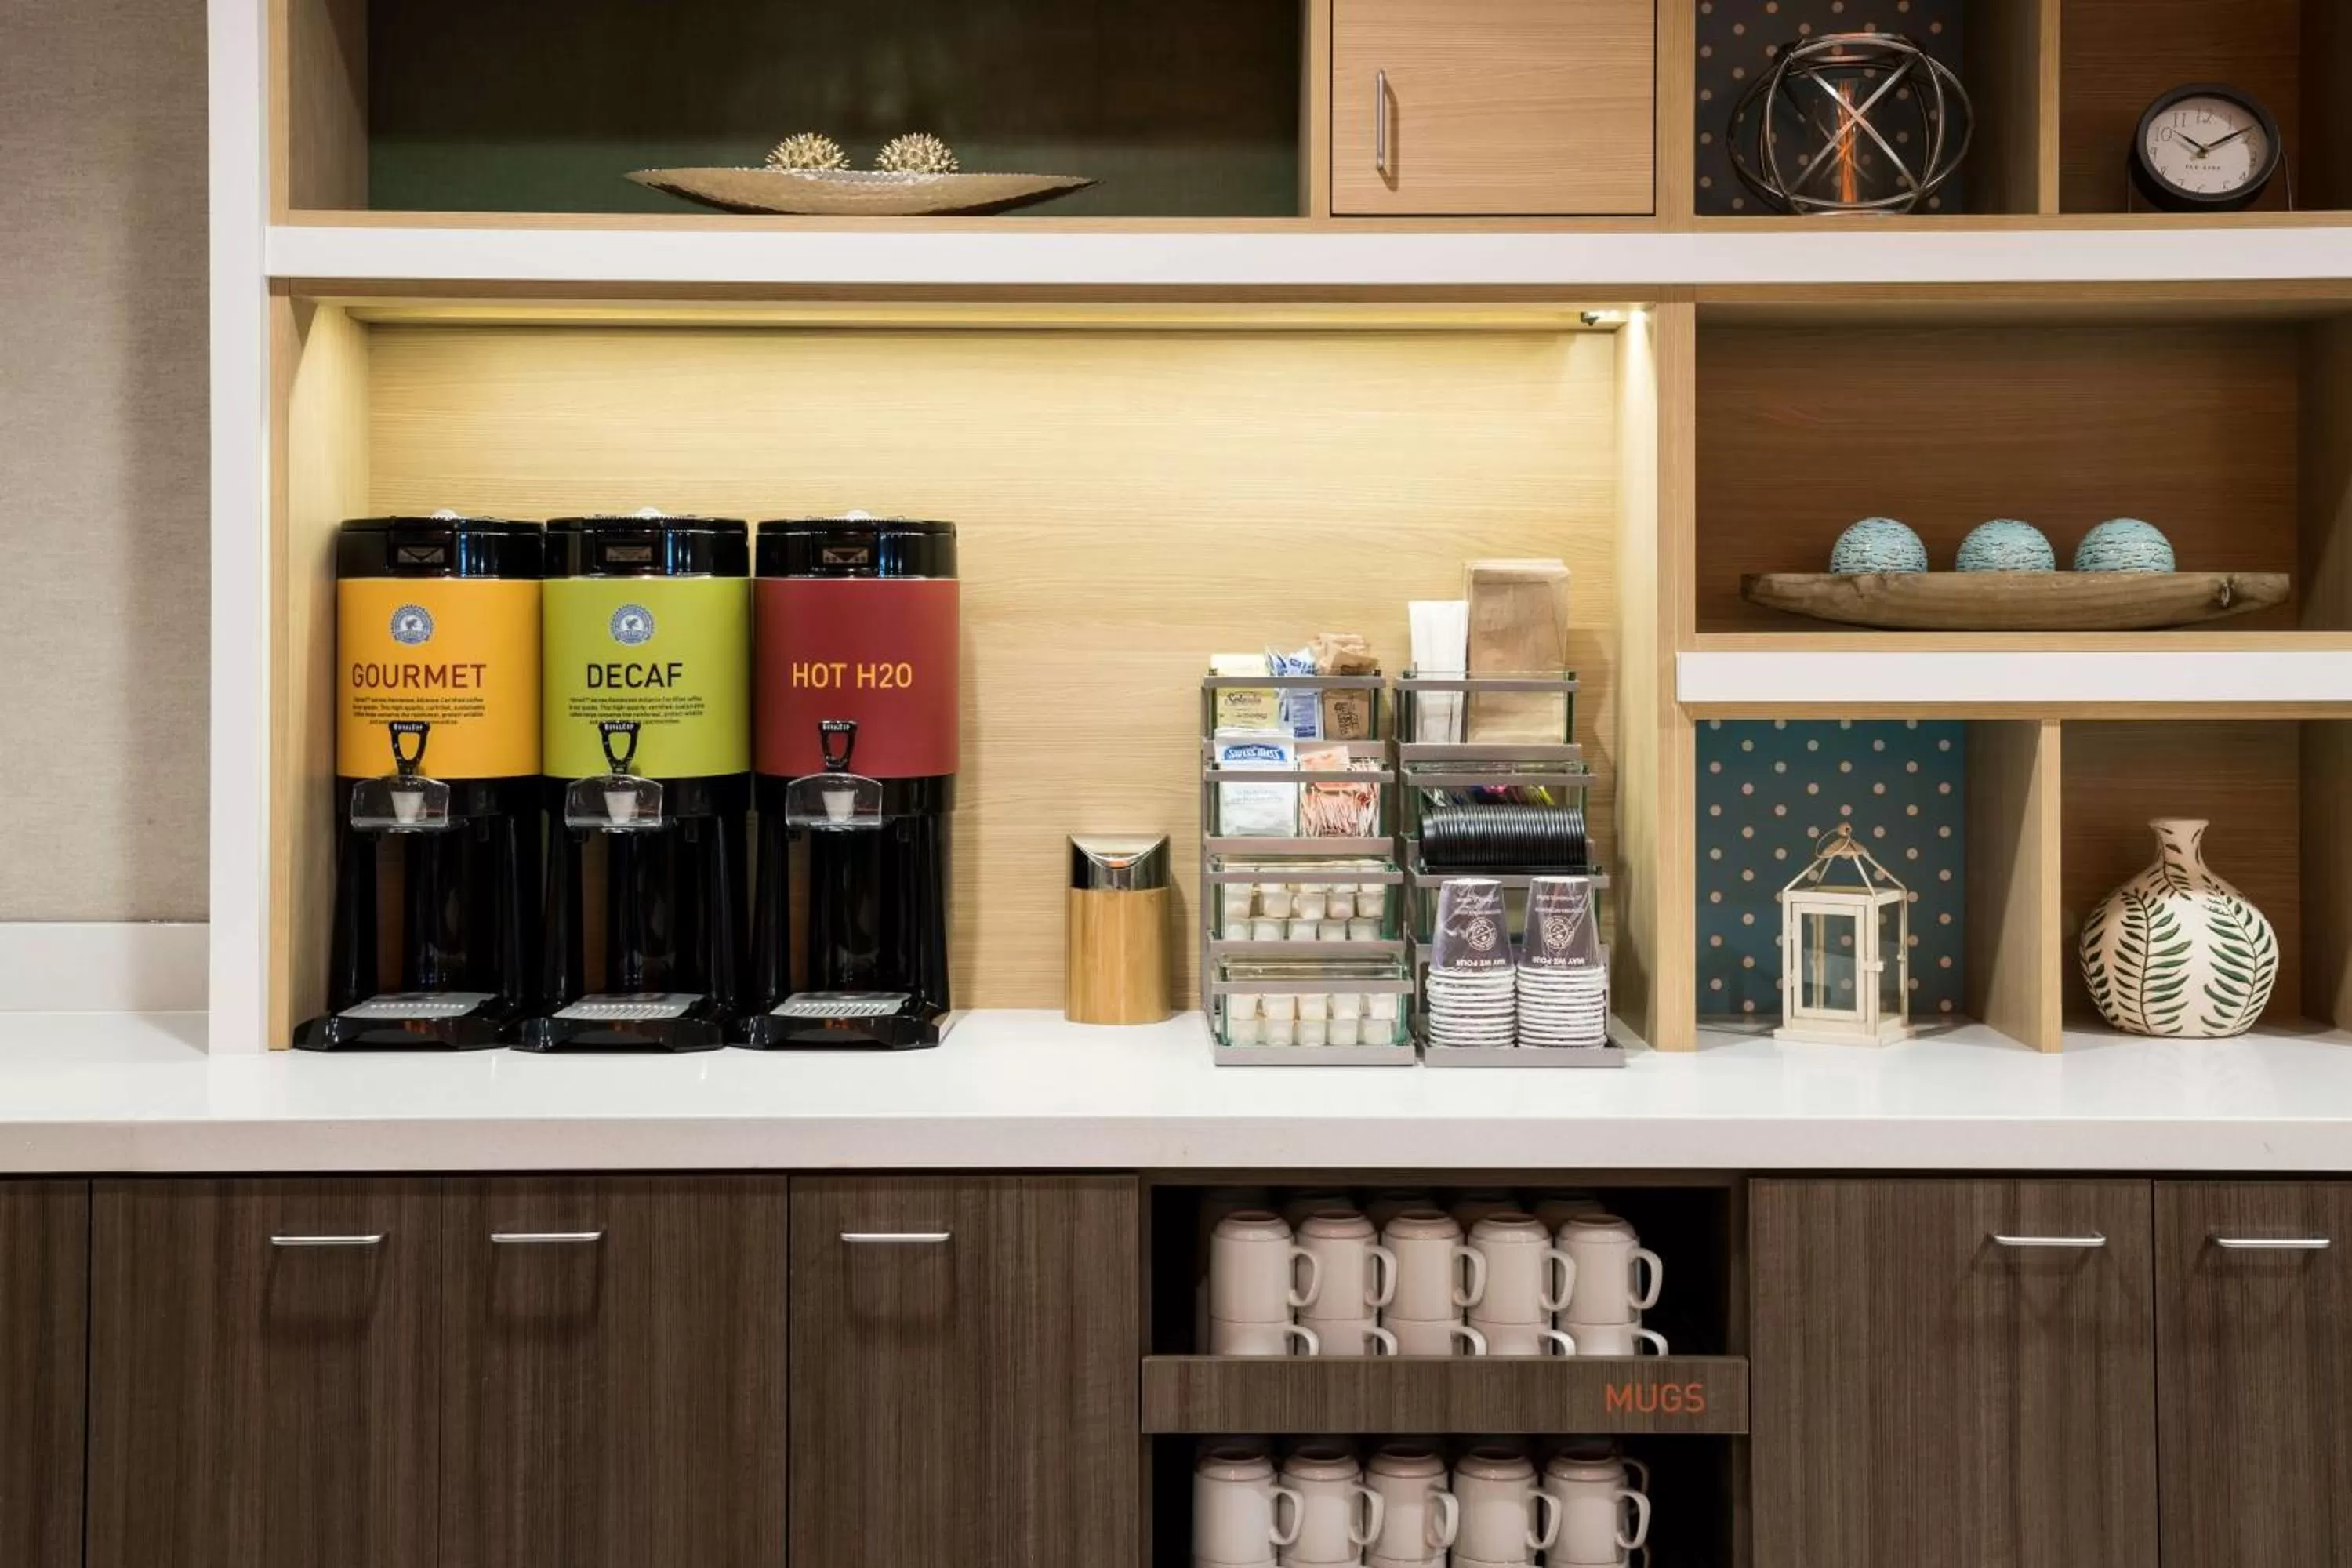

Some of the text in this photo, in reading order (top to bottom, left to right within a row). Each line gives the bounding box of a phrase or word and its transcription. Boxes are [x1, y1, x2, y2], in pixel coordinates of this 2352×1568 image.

[2173, 112, 2187, 128] 11
[2196, 106, 2214, 124] 12
[2155, 126, 2172, 142] 10
[2149, 147, 2158, 158] 9
[352, 662, 487, 689] GOURMET
[586, 662, 683, 689] DECAF
[792, 662, 848, 688] HOT
[1605, 1382, 1707, 1414] MUGS
